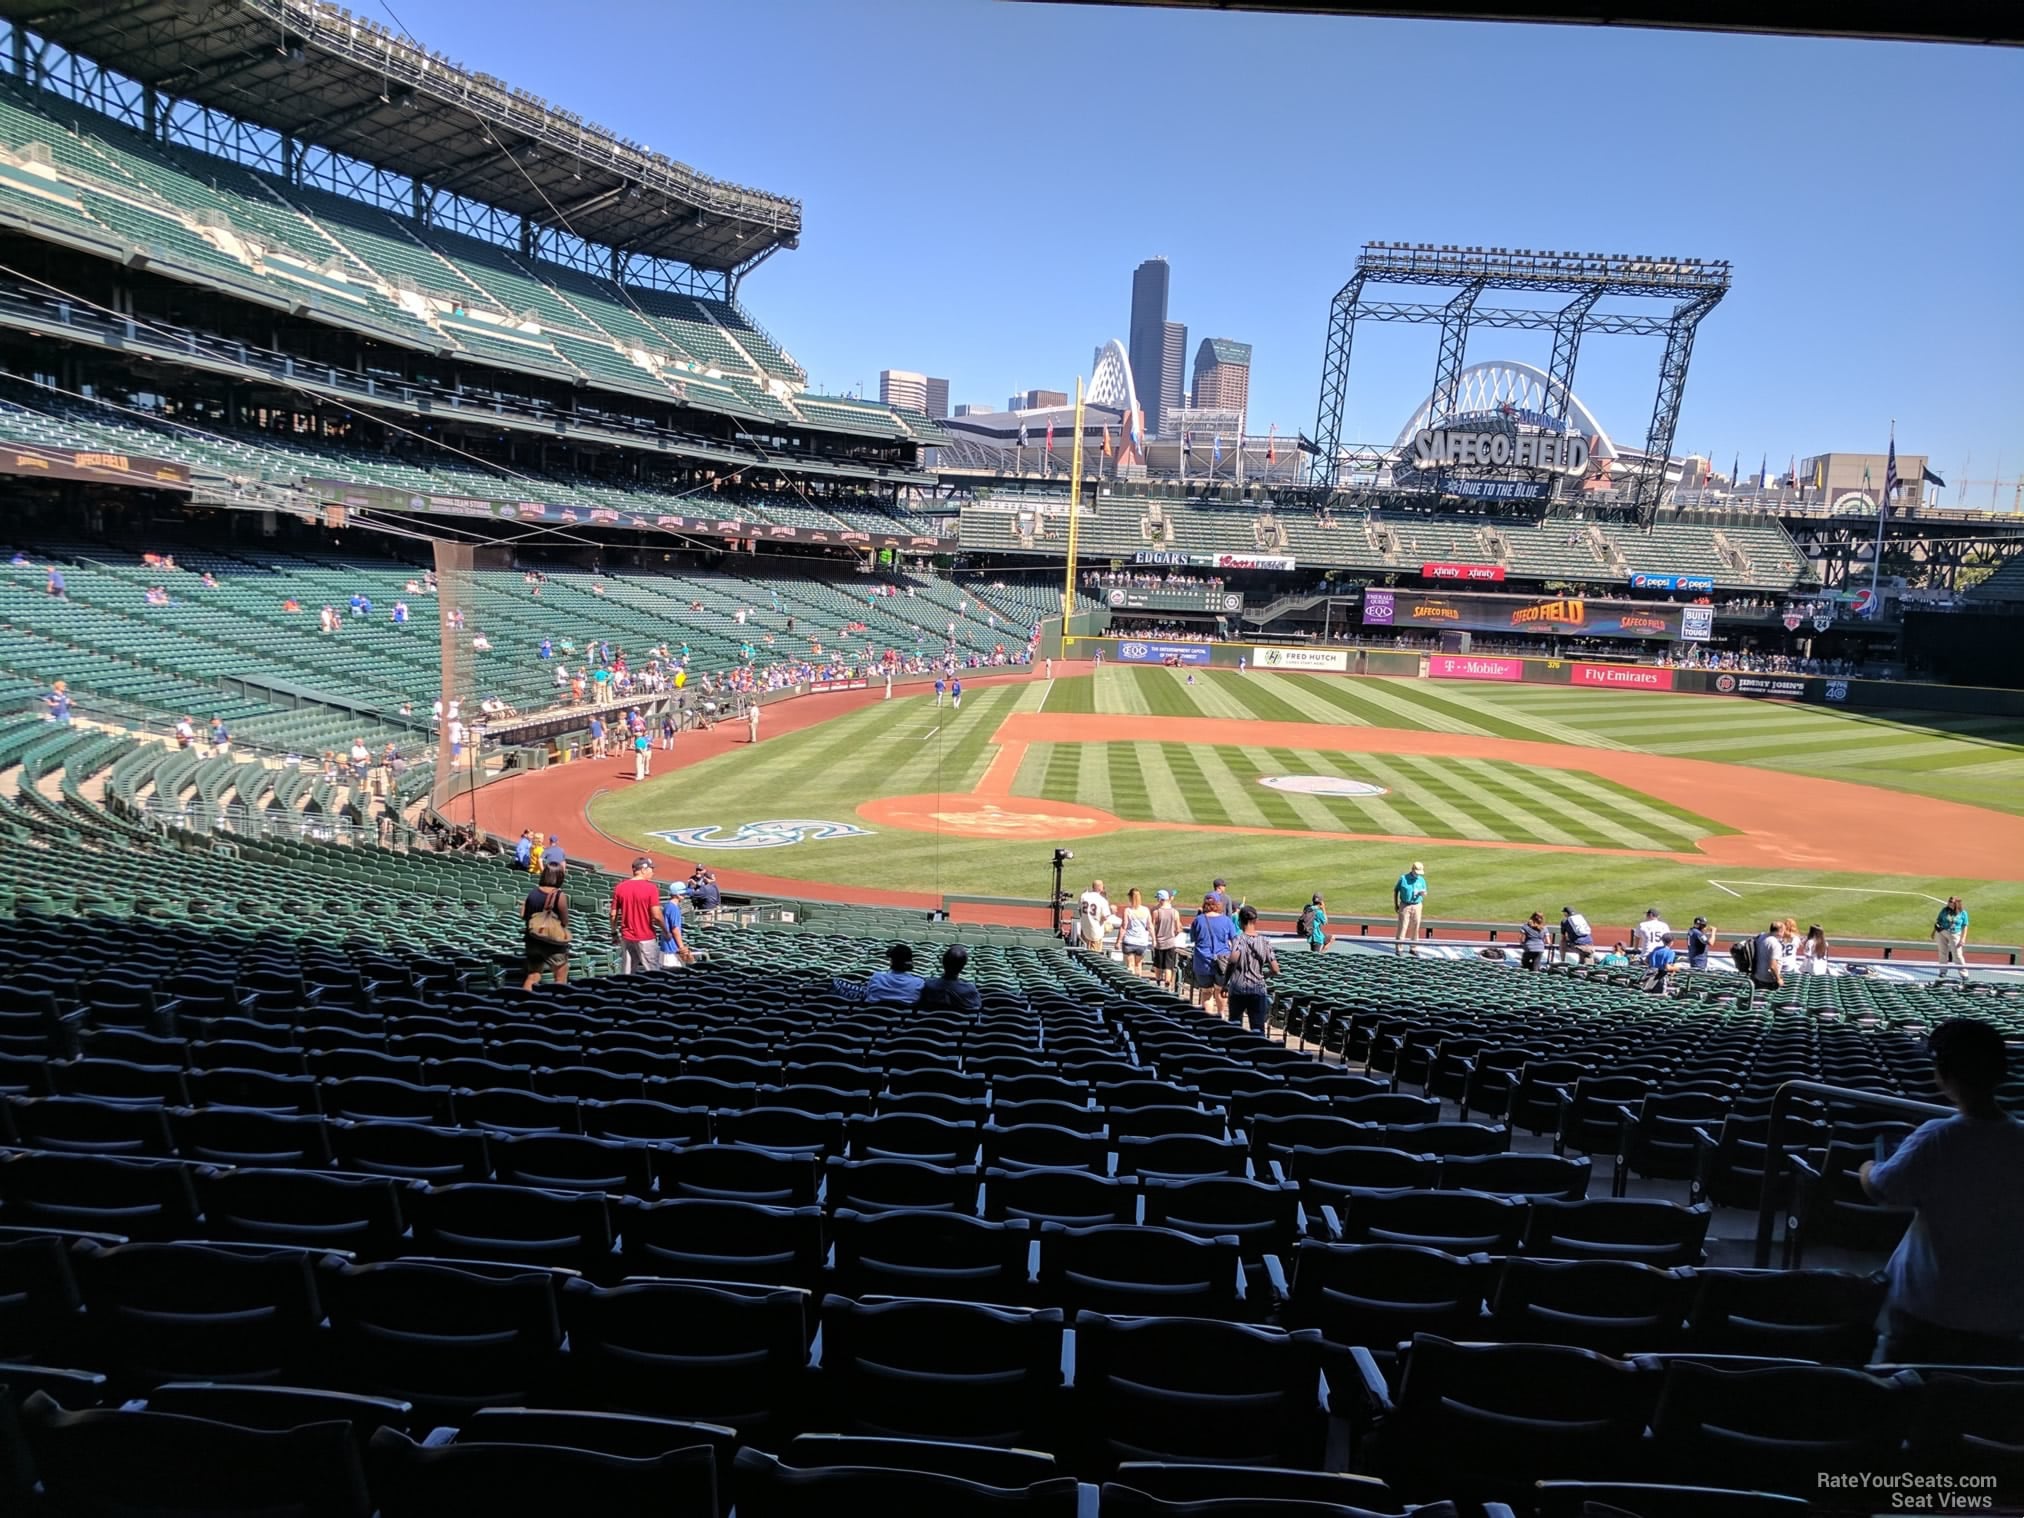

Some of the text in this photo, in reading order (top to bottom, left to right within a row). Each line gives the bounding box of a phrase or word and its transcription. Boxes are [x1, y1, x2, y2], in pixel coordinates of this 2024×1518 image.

[1414, 429, 1589, 477] SAFECO FIELD
[1483, 483, 1496, 496] TO
[1496, 484, 1515, 497] THE
[1135, 552, 1188, 565] EDGARS
[1433, 566, 1460, 578] xfinity
[1468, 568, 1495, 579] xfinity
[1647, 578, 1670, 588] pepsi
[1689, 580, 1712, 590] pepsi
[1365, 606, 1393, 617] EQC
[1413, 606, 1459, 619] SAFECO FIELD
[1540, 600, 1584, 625] FIELD
[1686, 611, 1709, 620] BUILT
[1309, 654, 1337, 662] HUTCH
[1585, 668, 1657, 683] Fly Emirates
[1739, 679, 1770, 687] JIMMY
[1082, 901, 1097, 916] 23
[1650, 931, 1661, 943] 15
